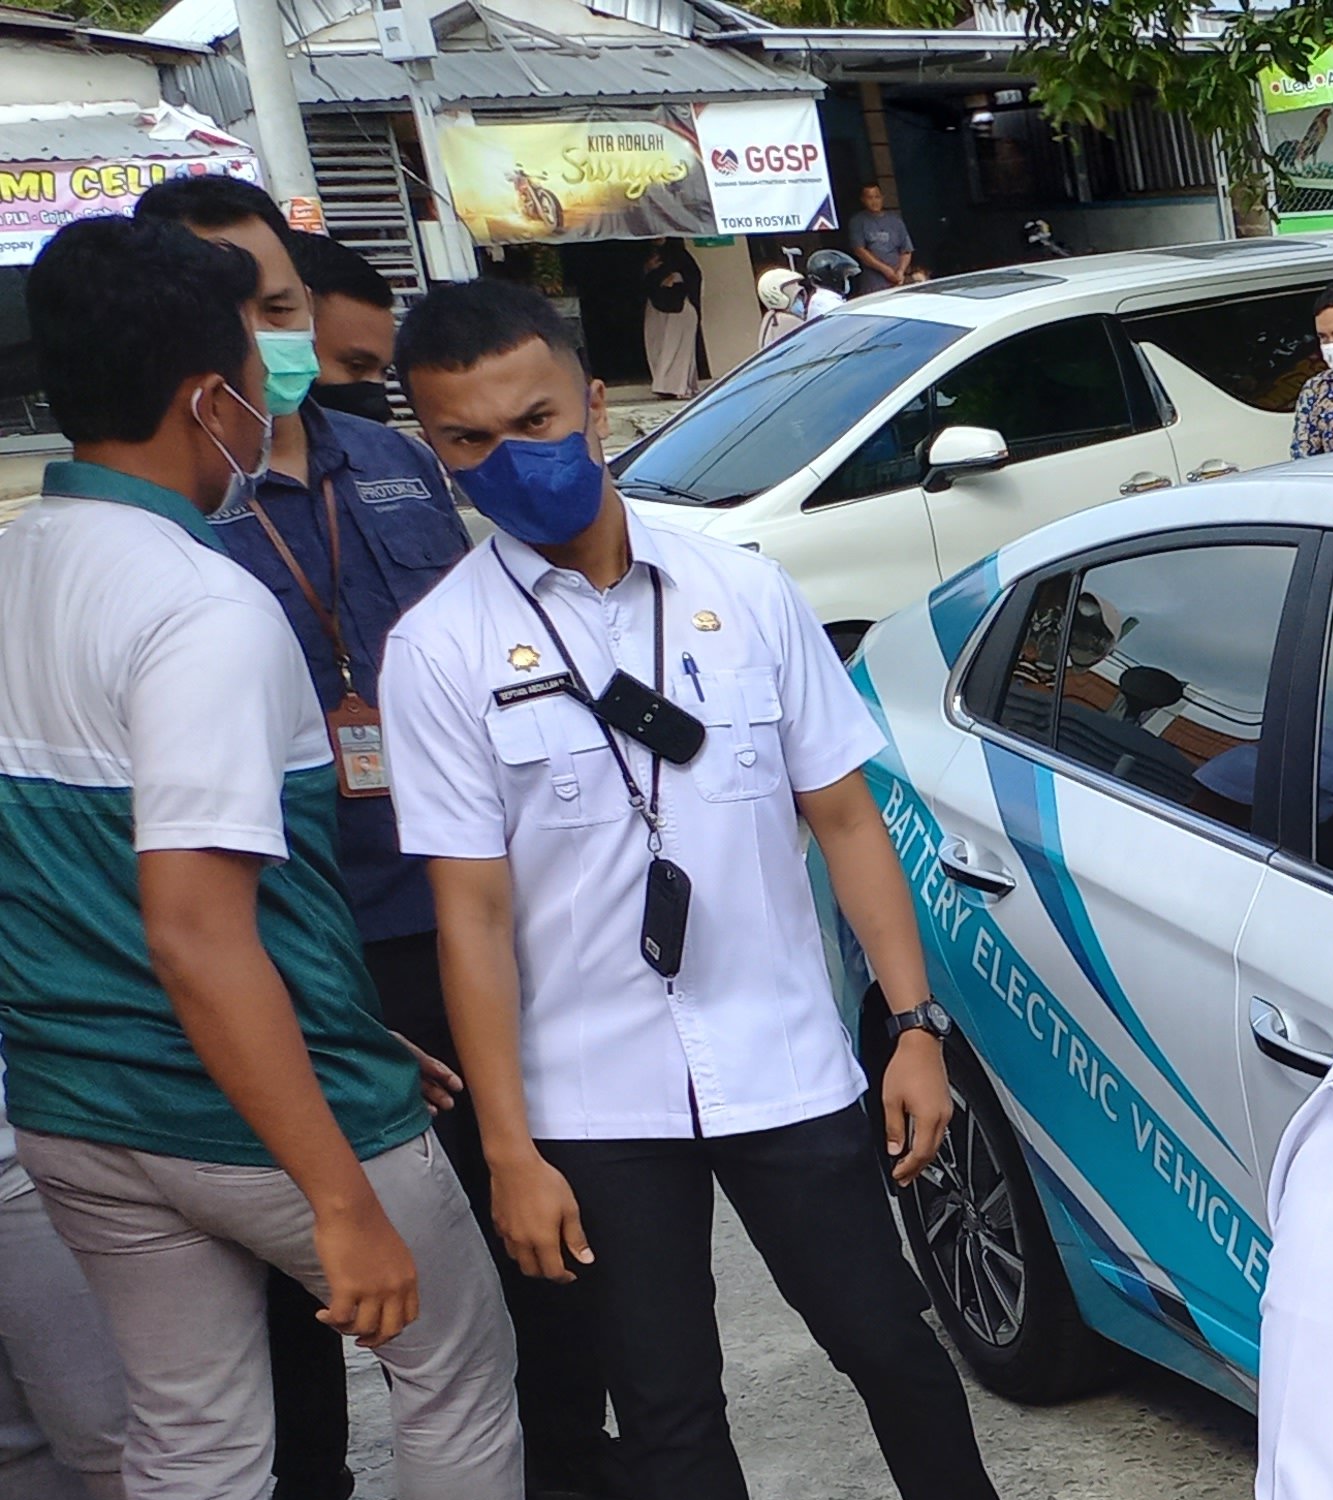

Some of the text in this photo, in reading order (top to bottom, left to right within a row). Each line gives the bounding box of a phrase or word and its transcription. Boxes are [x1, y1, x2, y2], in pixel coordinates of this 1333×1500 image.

[587, 134, 664, 153] KITA ADALAH
[745, 144, 818, 173] GGSP
[562, 146, 689, 200] Surya
[721, 215, 801, 229] TOKO ROSYATI
[359, 483, 425, 499] PROTOKOL
[881, 778, 1271, 1294] BATTERY ELECTRIC VEHICLE
